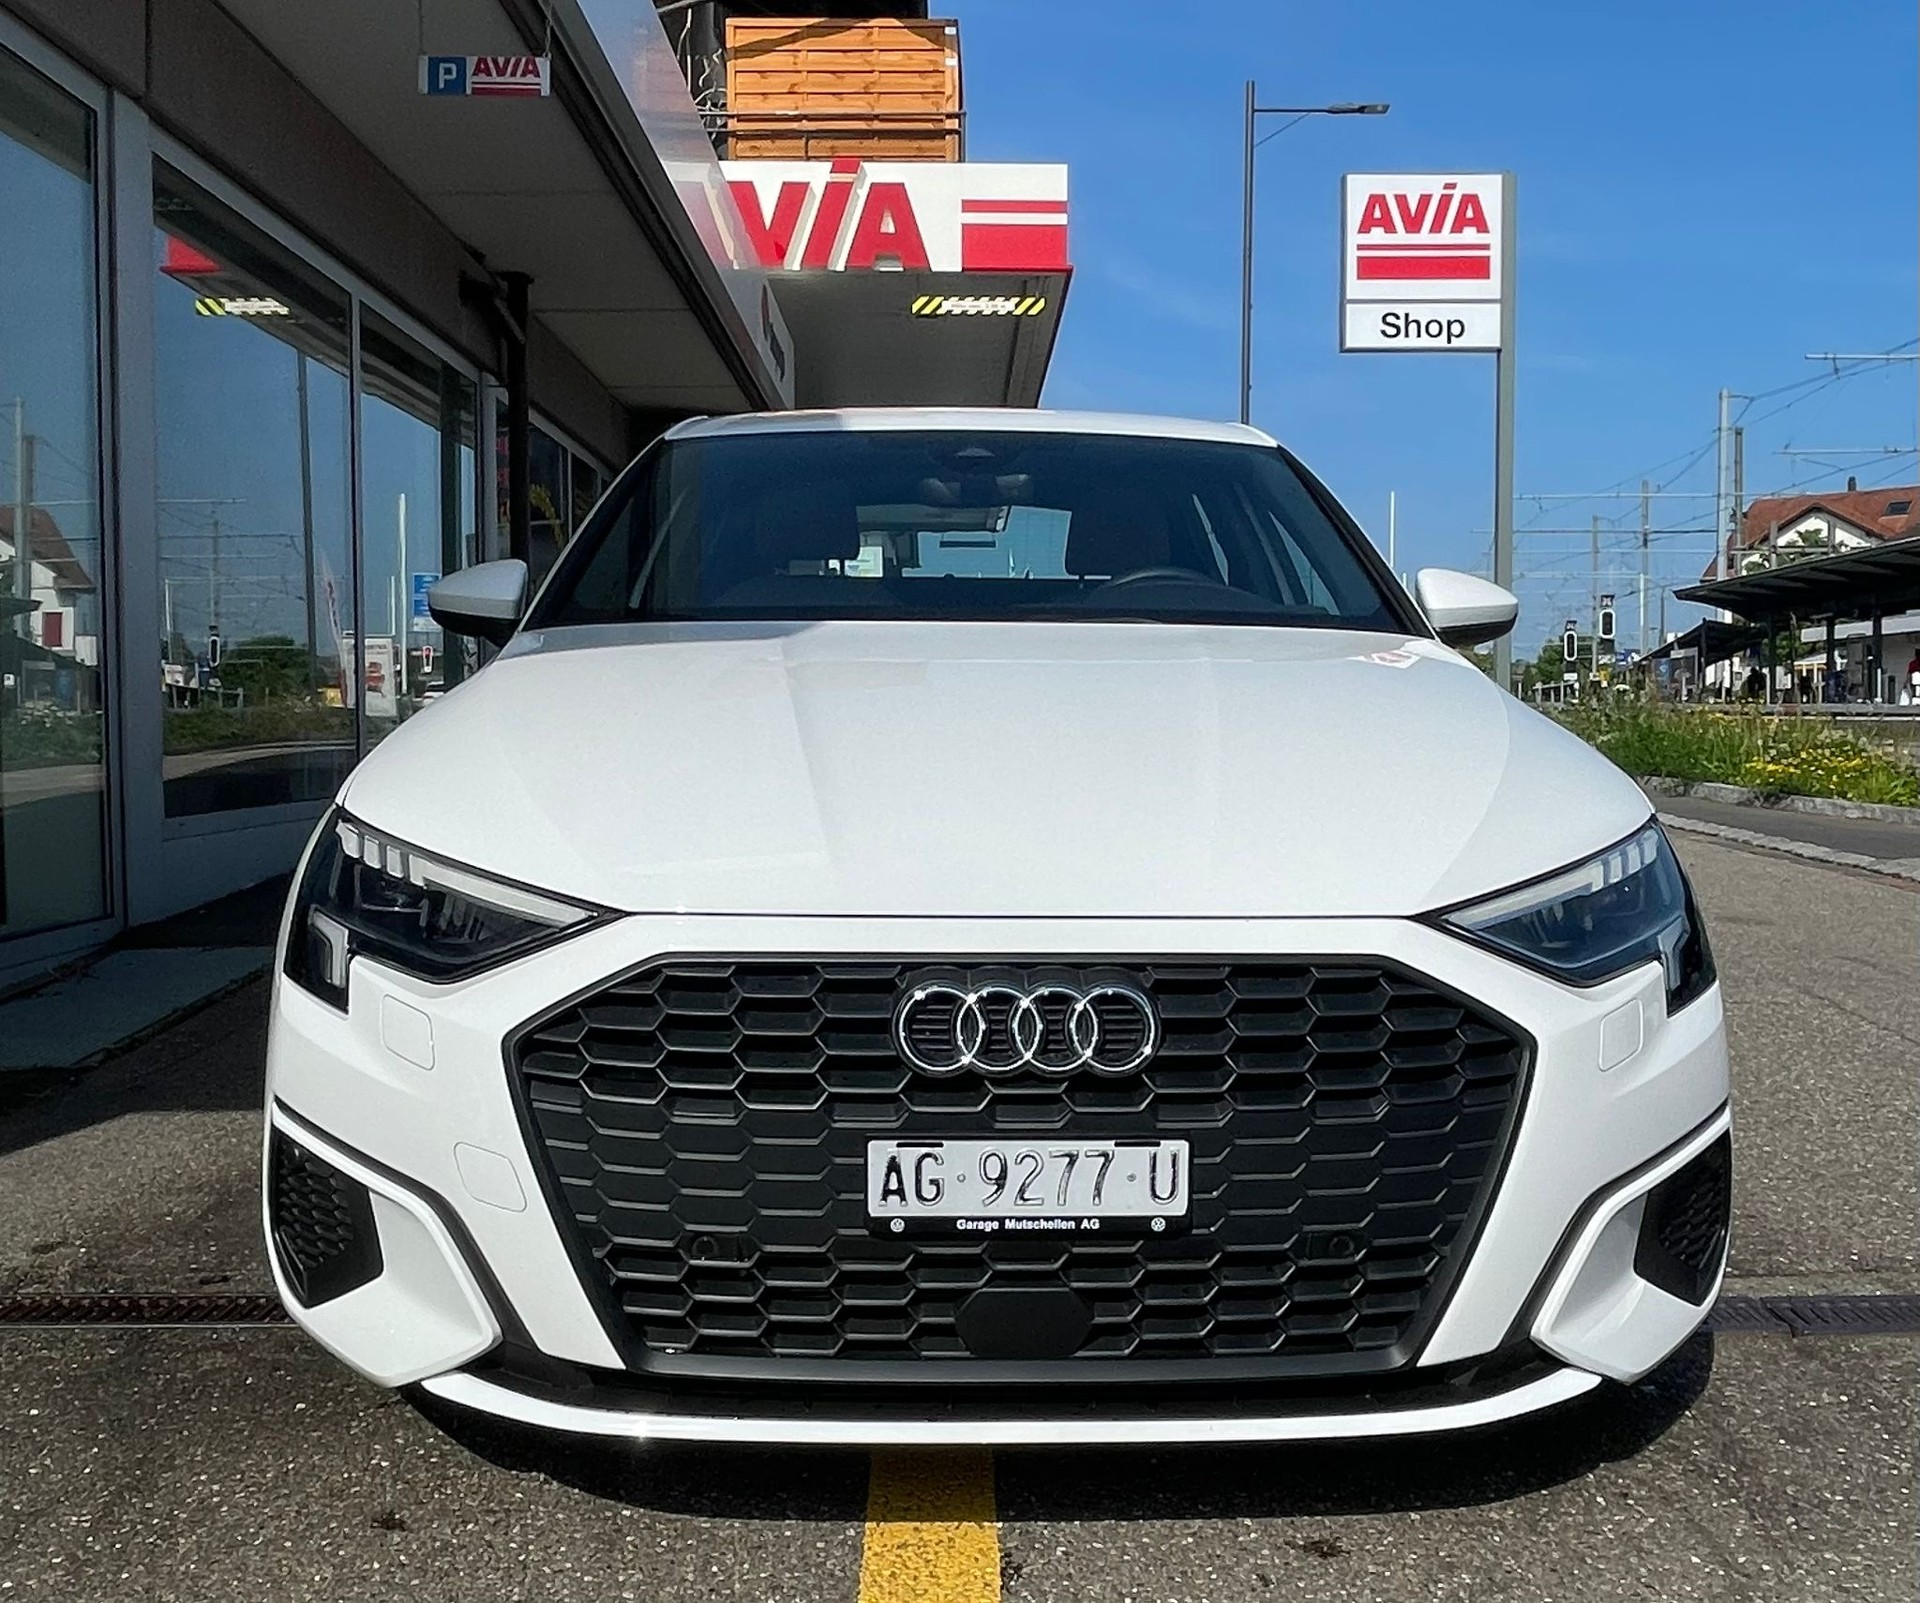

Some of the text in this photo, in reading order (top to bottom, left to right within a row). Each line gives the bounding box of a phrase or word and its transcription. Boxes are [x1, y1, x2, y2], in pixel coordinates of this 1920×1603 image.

[439, 55, 542, 90] P AVIA
[726, 156, 933, 271] VIA
[1357, 182, 1491, 235] AVIA
[1379, 311, 1466, 344] Shop
[878, 1149, 1180, 1208] AG 9277 U
[956, 1218, 1000, 1232] Garage
[1080, 1218, 1100, 1230] AG
